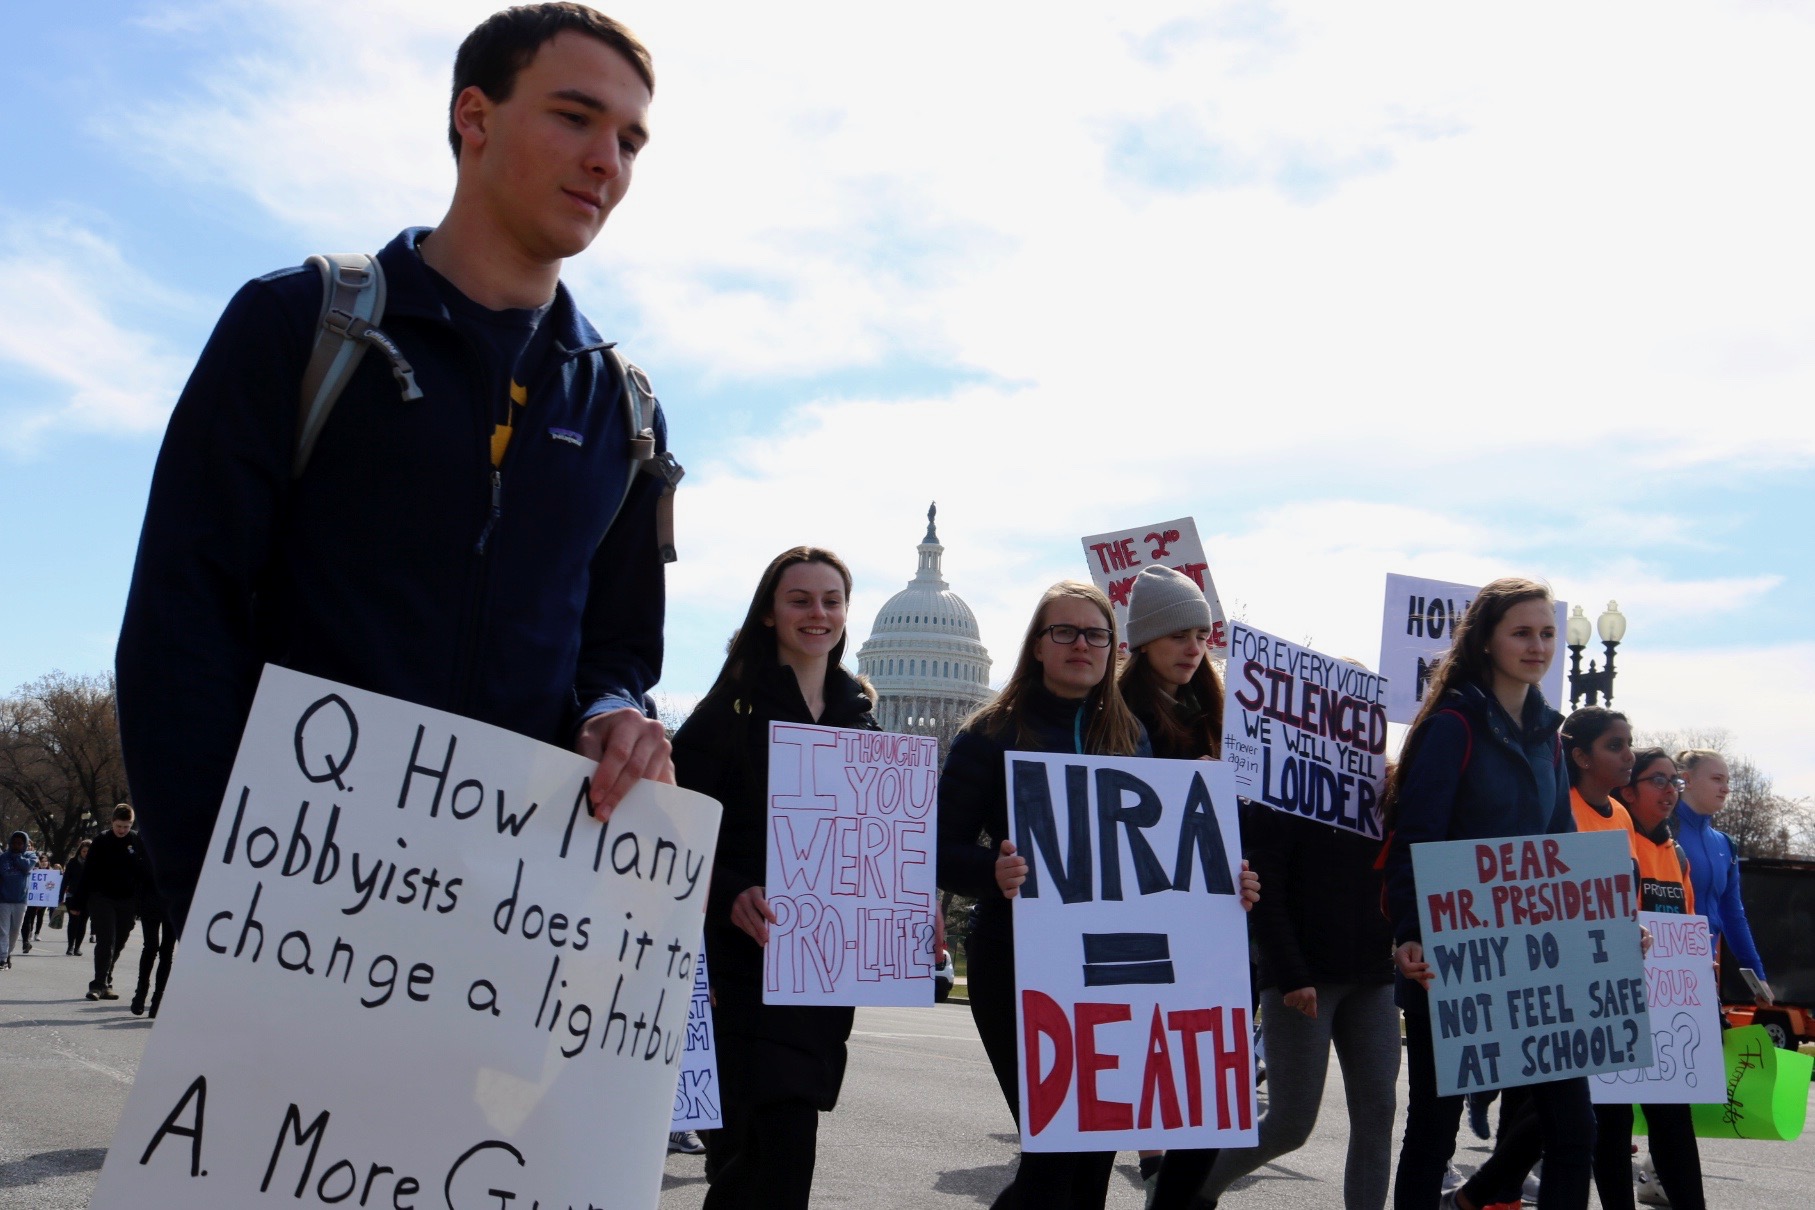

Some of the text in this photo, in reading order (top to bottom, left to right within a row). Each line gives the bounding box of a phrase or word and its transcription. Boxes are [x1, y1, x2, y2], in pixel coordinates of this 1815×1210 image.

[1090, 538, 1142, 574] THE
[1232, 625, 1270, 668] FOR
[1273, 641, 1335, 687] EVERY
[1337, 665, 1388, 708] VOICE
[1234, 660, 1388, 755] SILENCED
[771, 725, 937, 811] I THOUGHT
[1224, 733, 1259, 756] #never
[1227, 753, 1259, 774] again
[1242, 709, 1378, 780] WE WILL YELL
[294, 693, 704, 901] Q. How Many
[844, 766, 937, 819] YOU
[1262, 746, 1381, 838] LOUDER
[773, 816, 930, 908] WERE
[1012, 760, 1235, 904] NRA
[1475, 839, 1571, 884] DEAR
[222, 786, 463, 915] lobbyists
[494, 859, 592, 950] does
[619, 912, 653, 970] it
[668, 937, 691, 980] ta
[1427, 874, 1638, 933] MR. PRESIDENT,
[1643, 882, 1684, 899] PROTECT
[206, 882, 680, 1065] change a lightbu
[1433, 929, 1609, 987] WHY DO I
[1650, 920, 1709, 958] LIVES
[1438, 978, 1646, 1039] NOT FEEL SAFE
[1644, 966, 1701, 1008] YOUR
[1022, 990, 1252, 1137] DEATH
[1457, 1018, 1639, 1089] AT SCHOOL?
[139, 1075, 208, 1177] A.
[259, 1103, 420, 1210] More
